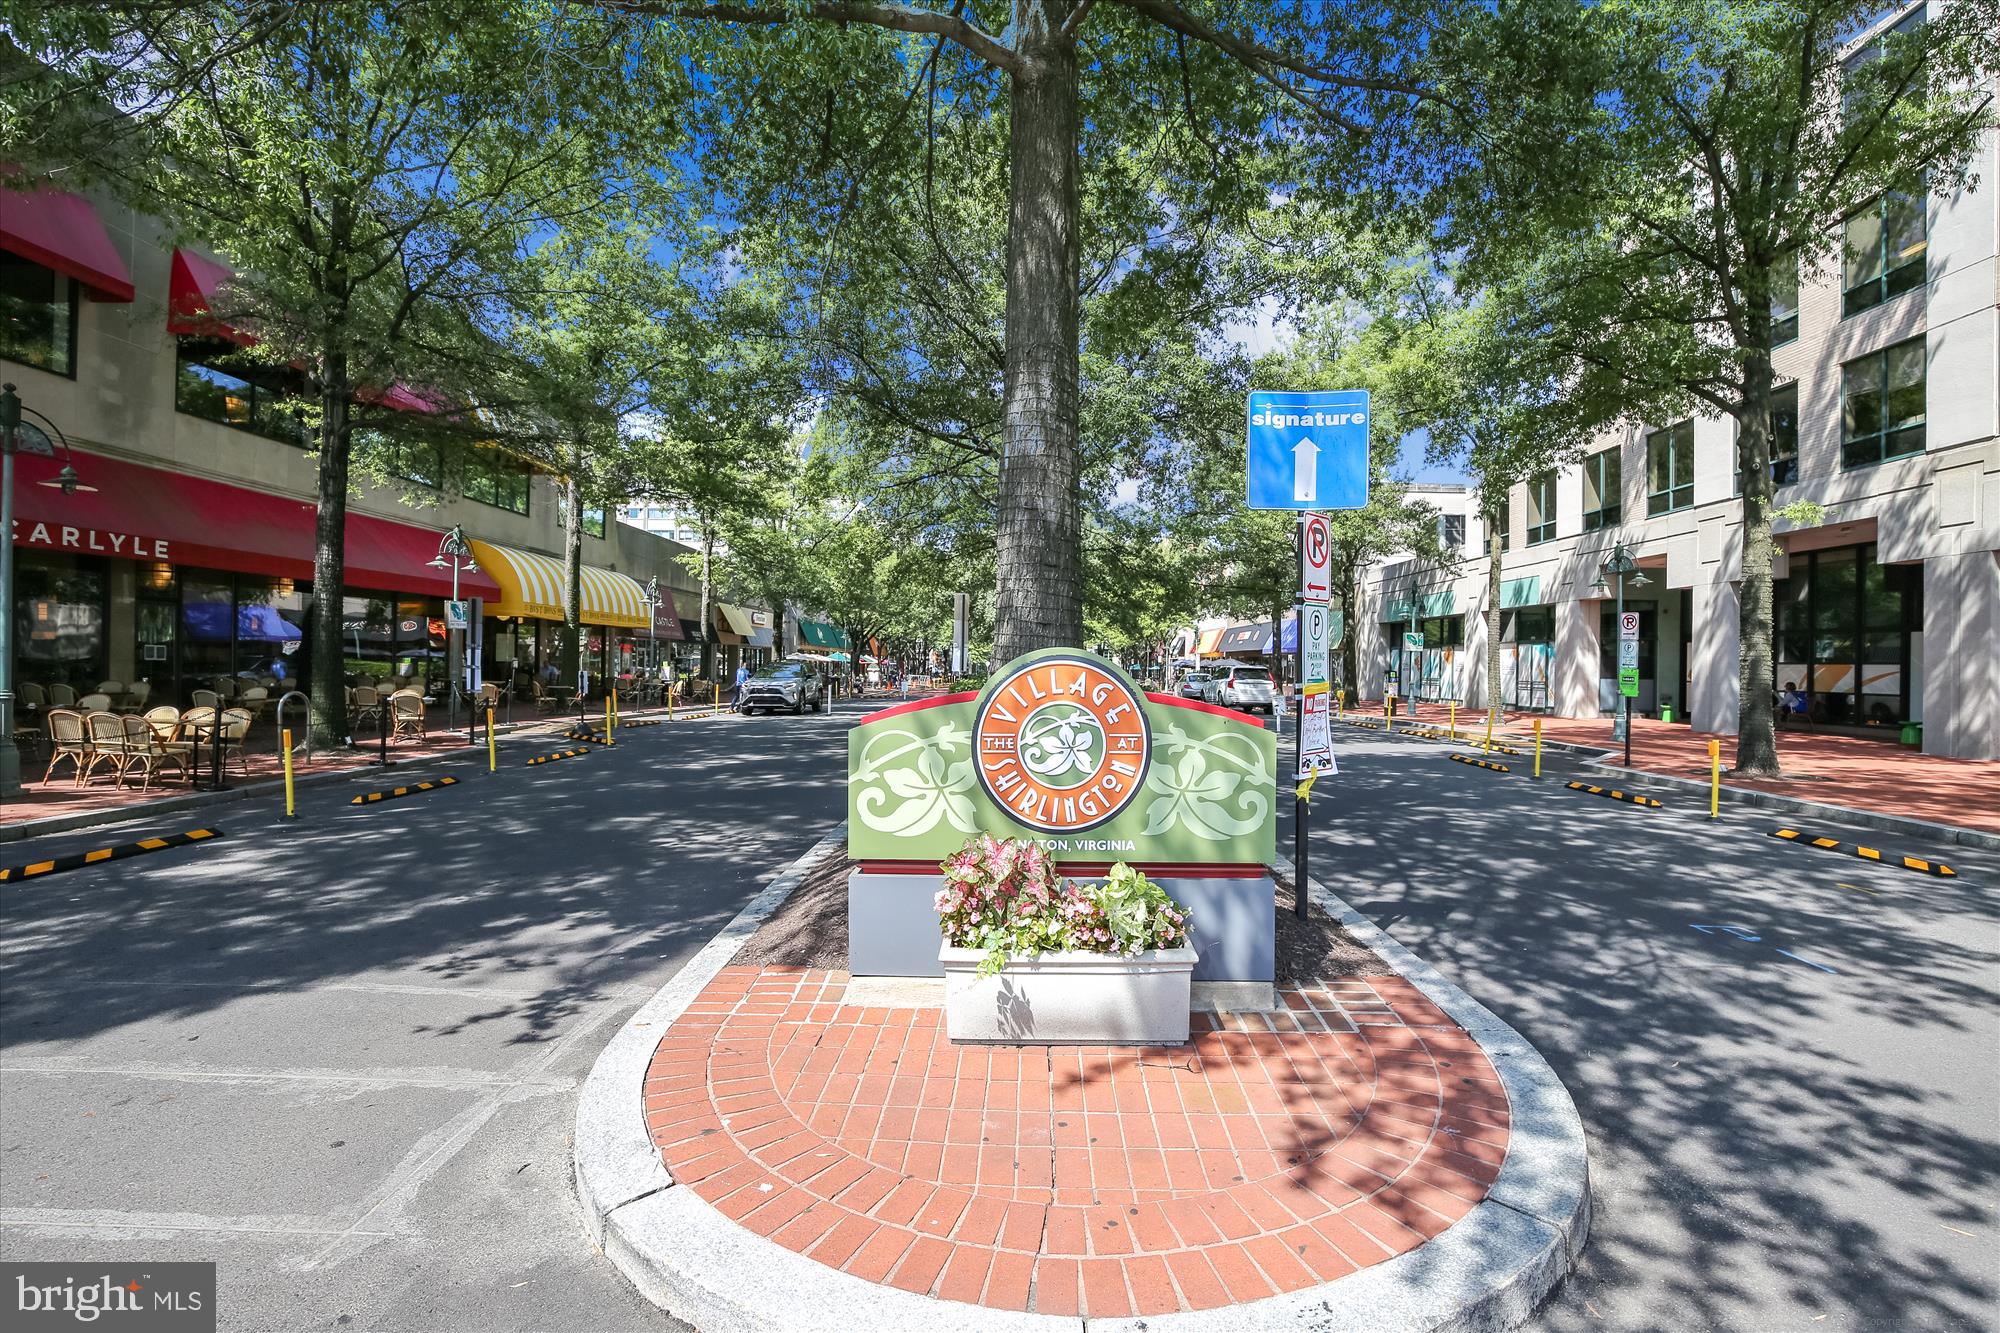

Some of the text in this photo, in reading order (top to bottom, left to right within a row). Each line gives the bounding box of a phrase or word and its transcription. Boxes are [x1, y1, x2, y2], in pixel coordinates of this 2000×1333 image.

[1252, 409, 1366, 429] signature
[990, 669, 1131, 725] VILLAGE
[984, 737, 1015, 749] THE
[1117, 737, 1139, 749] AT
[984, 758, 1137, 823] SHIRLINGTON
[1075, 839, 1136, 851] VIRGINIA
